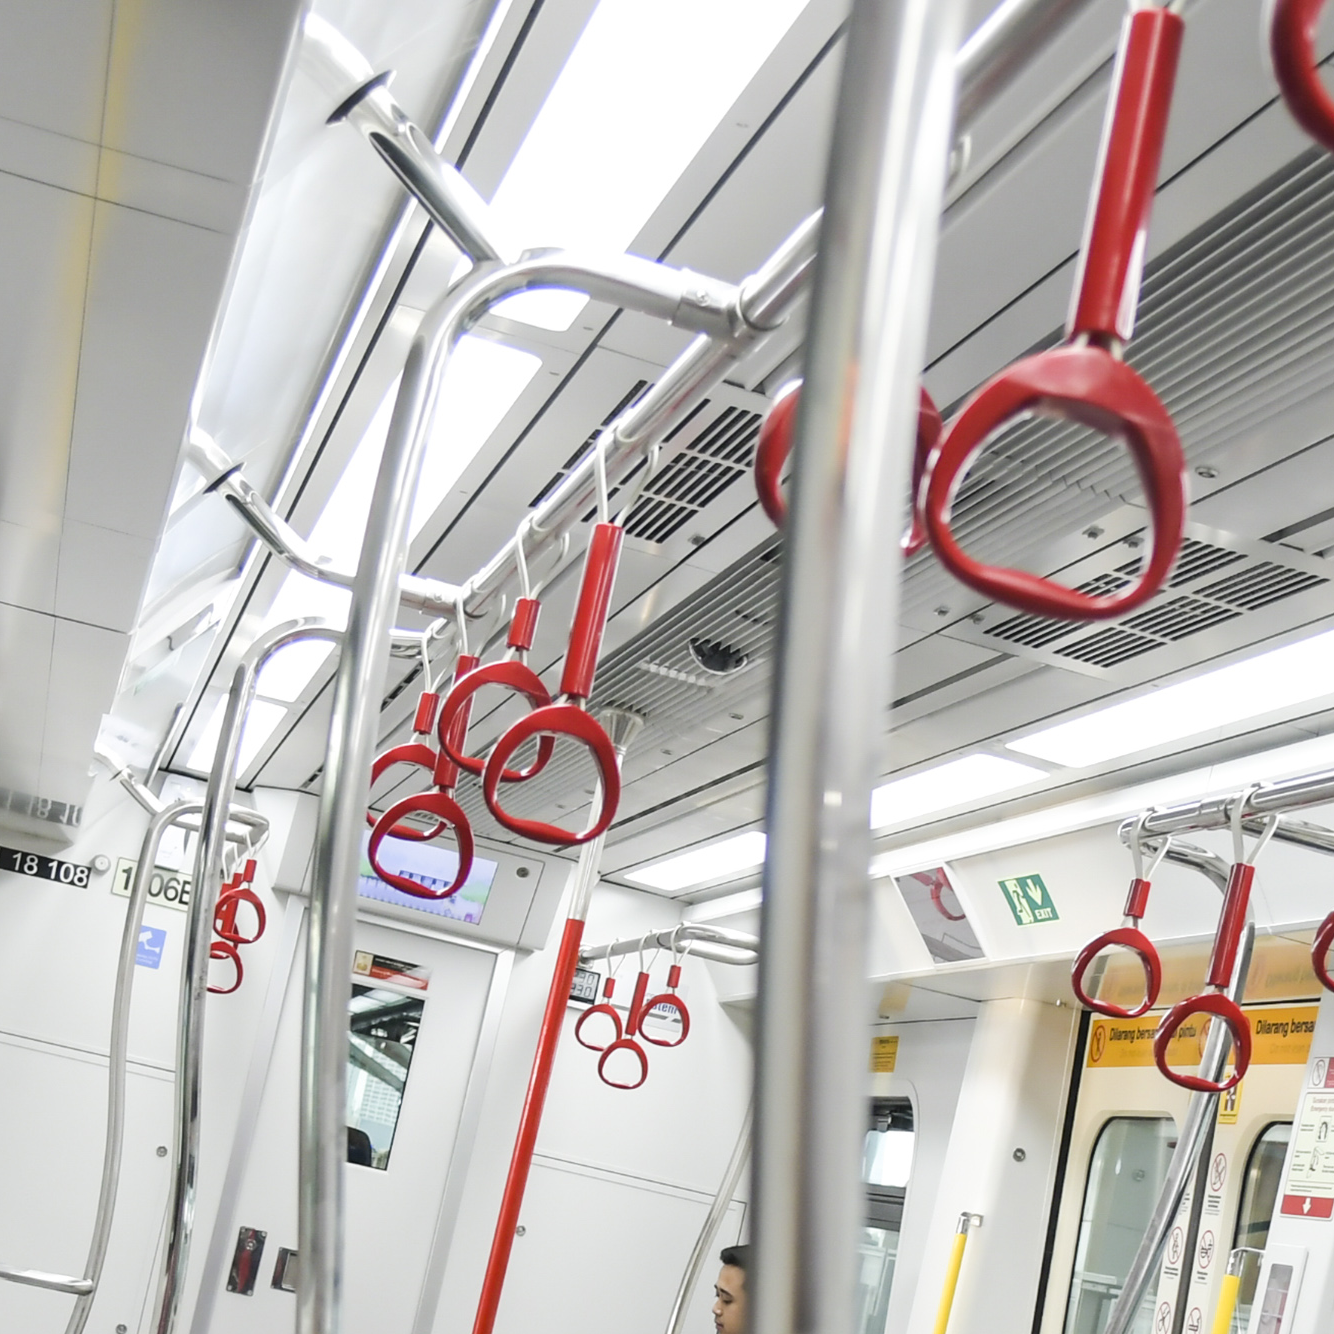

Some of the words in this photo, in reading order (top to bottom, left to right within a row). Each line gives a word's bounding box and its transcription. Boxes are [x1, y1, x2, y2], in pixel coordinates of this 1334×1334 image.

[13, 852, 39, 875] 18
[48, 860, 89, 887] 108
[1110, 1027, 1135, 1043] Dilarang
[1256, 1019, 1289, 1038] Dilarang
